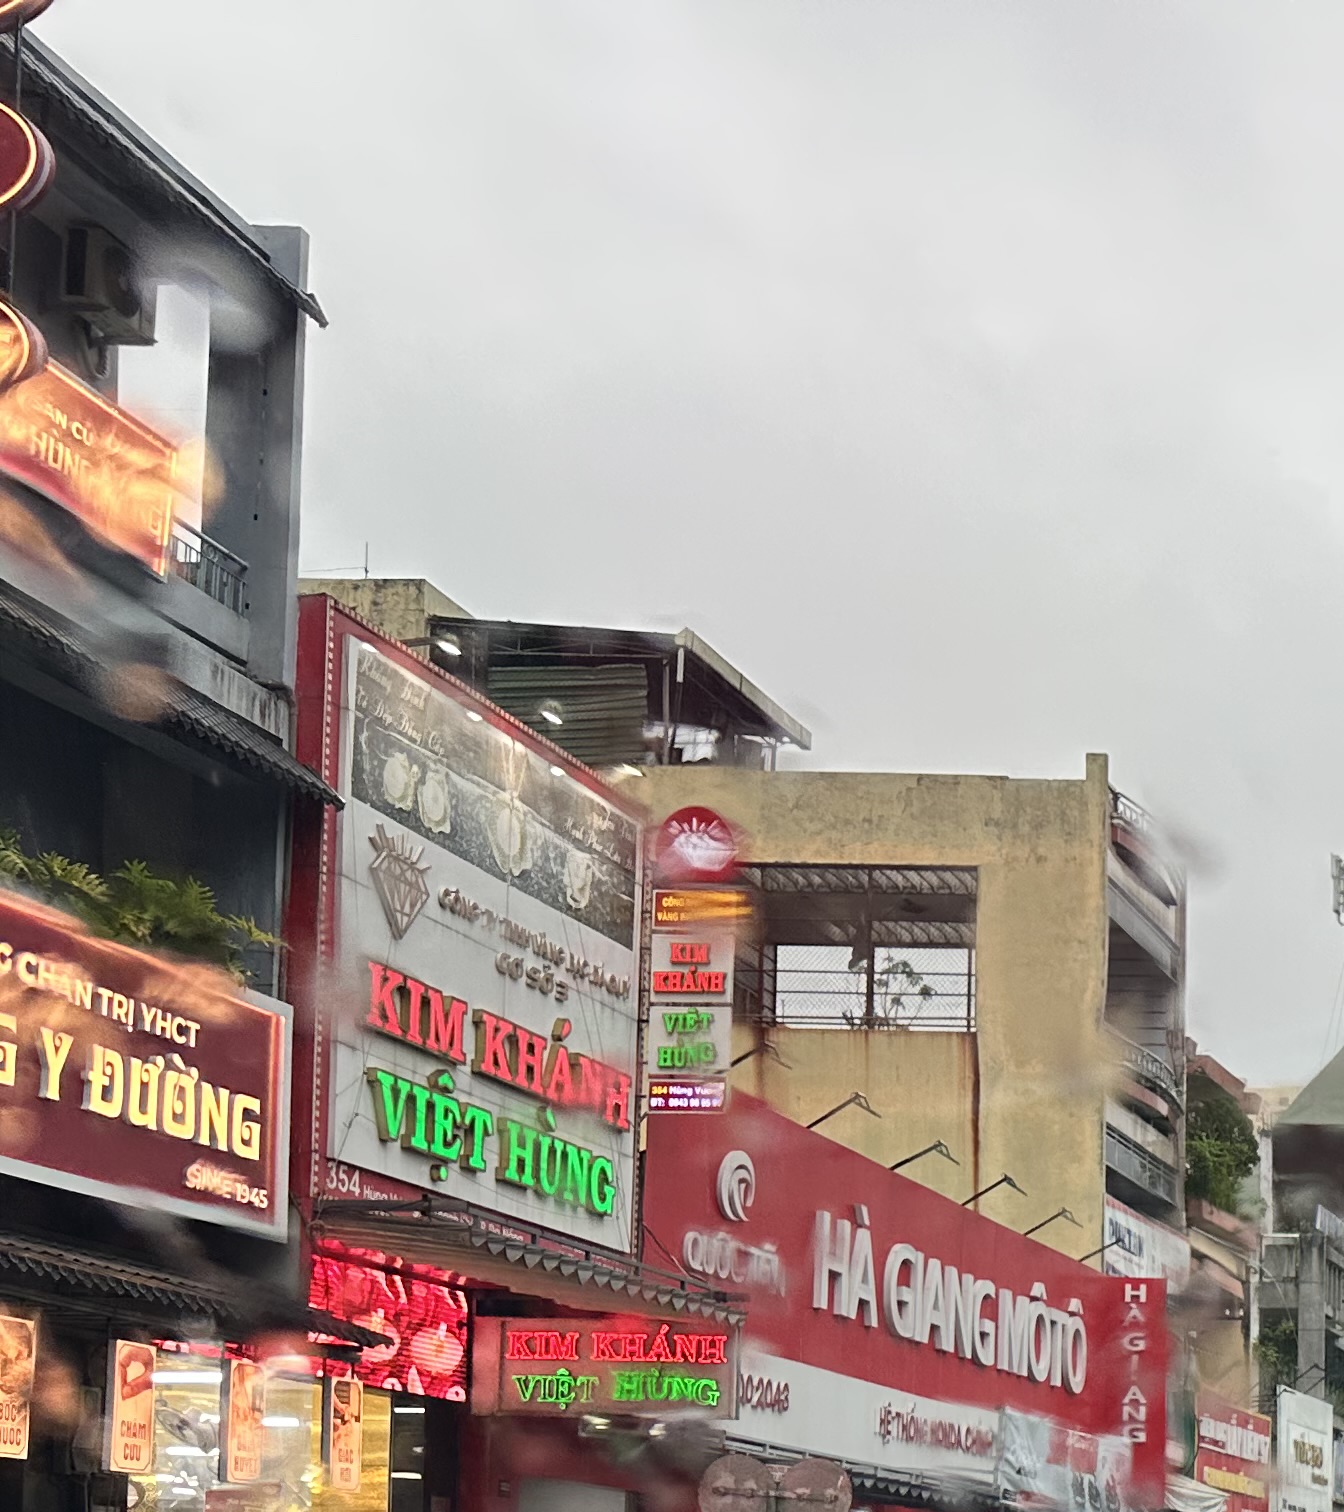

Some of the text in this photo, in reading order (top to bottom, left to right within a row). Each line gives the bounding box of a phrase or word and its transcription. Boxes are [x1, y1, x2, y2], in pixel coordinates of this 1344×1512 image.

[669, 942, 710, 964] KIM
[653, 966, 726, 993] KHÁNH
[98, 986, 135, 1033] TRỊ
[141, 1001, 201, 1048] YHCT
[366, 960, 632, 1132] KIM KHÁNH
[38, 1025, 75, 1102] Y
[81, 1042, 263, 1161] ĐƯỜNG
[370, 1067, 617, 1218] VIỆT HÙNG
[234, 1182, 268, 1209] 1945
[326, 1161, 362, 1198] 354
[812, 1203, 1088, 1395] HÀ GIANG MÔTÔ
[505, 1323, 729, 1365] KIM KHÁNH
[511, 1367, 721, 1410] VIỆT HÙNG
